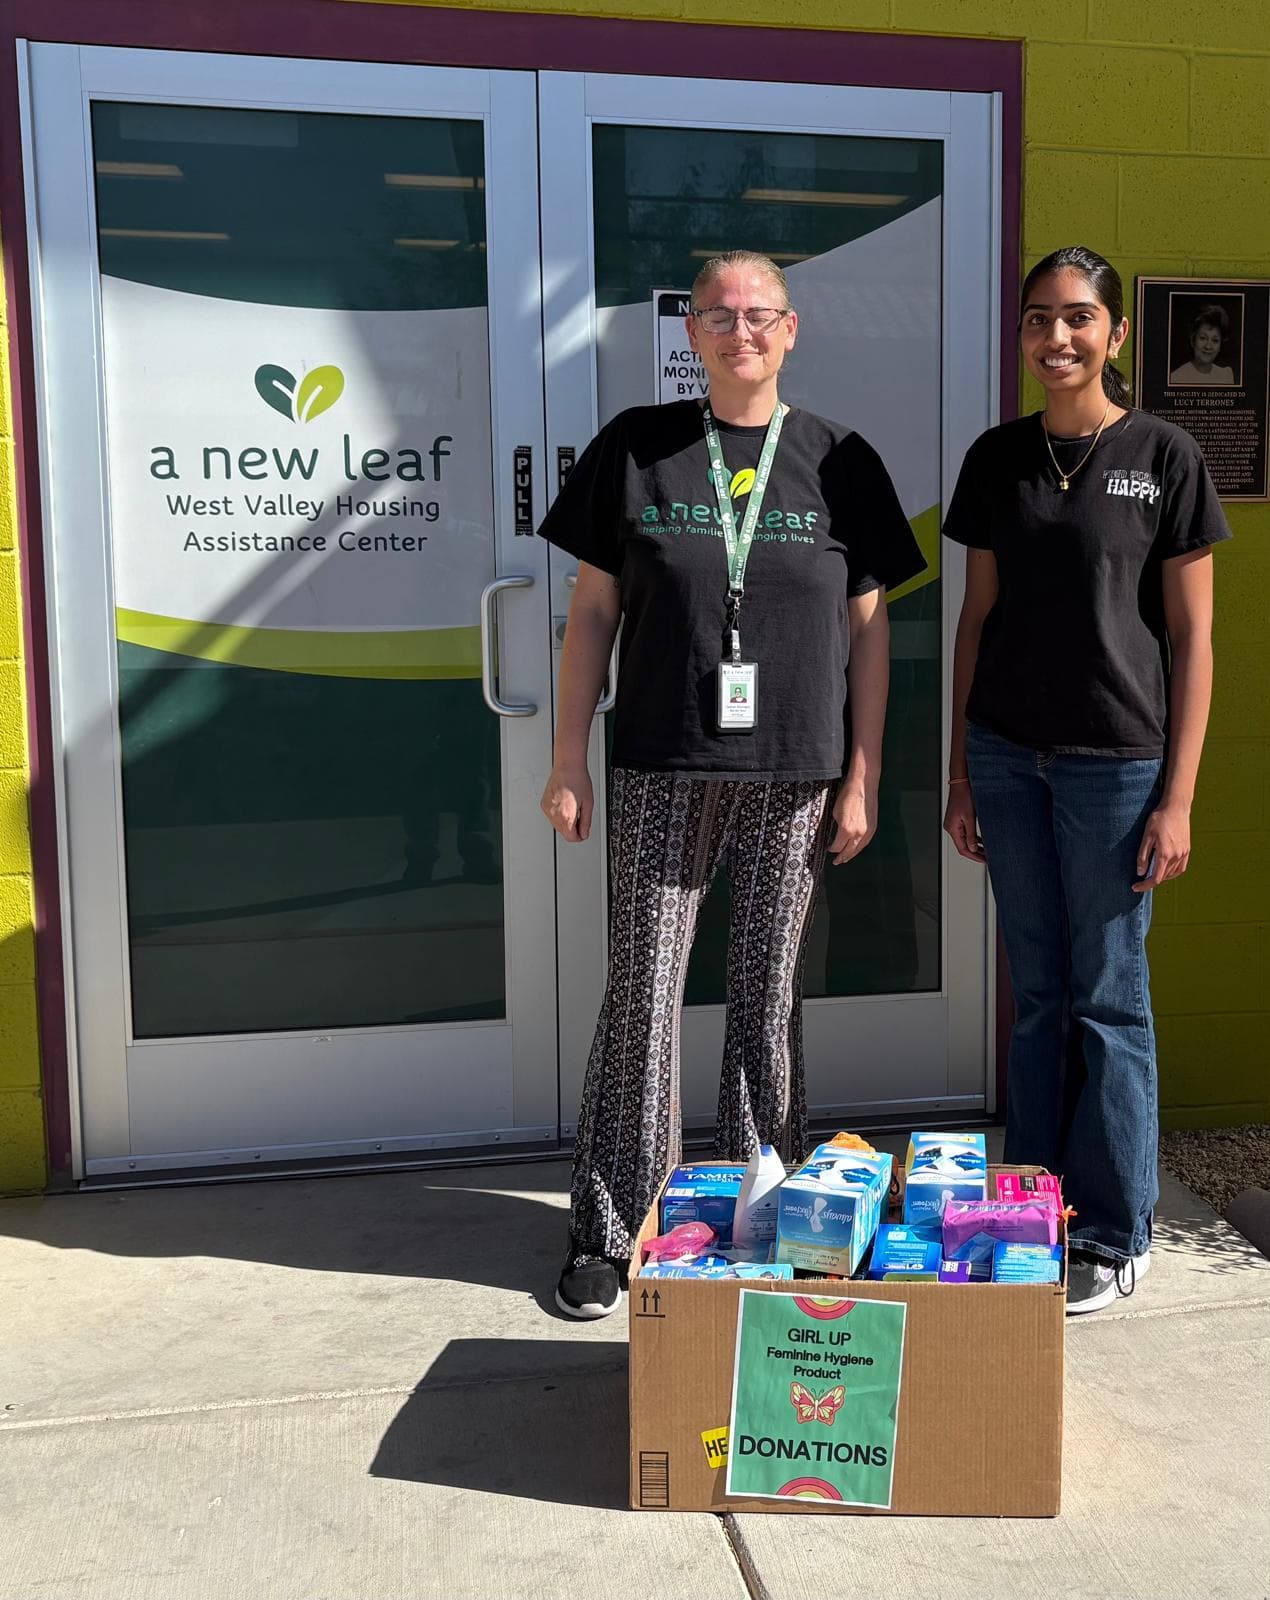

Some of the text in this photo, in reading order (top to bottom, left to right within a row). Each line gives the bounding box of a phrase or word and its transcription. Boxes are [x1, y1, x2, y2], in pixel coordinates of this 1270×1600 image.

[664, 366, 705, 378] MONI
[678, 383, 694, 394] BY
[150, 434, 452, 481] a new leaf
[517, 458, 529, 520] PULL
[1106, 479, 1160, 504] HAPPY
[166, 494, 440, 522] West Valley Housing
[642, 506, 658, 522] a
[184, 531, 427, 552] Assistance Center
[643, 525, 681, 535] helping
[686, 525, 724, 537] familie
[790, 533, 814, 544] lives
[823, 1209, 852, 1224] always
[788, 1328, 852, 1346] GIRL UP
[767, 1347, 874, 1367] Feminine Hygiene
[793, 1366, 841, 1380] Product
[705, 1437, 728, 1458] HE
[739, 1435, 887, 1466] DONATIONS
